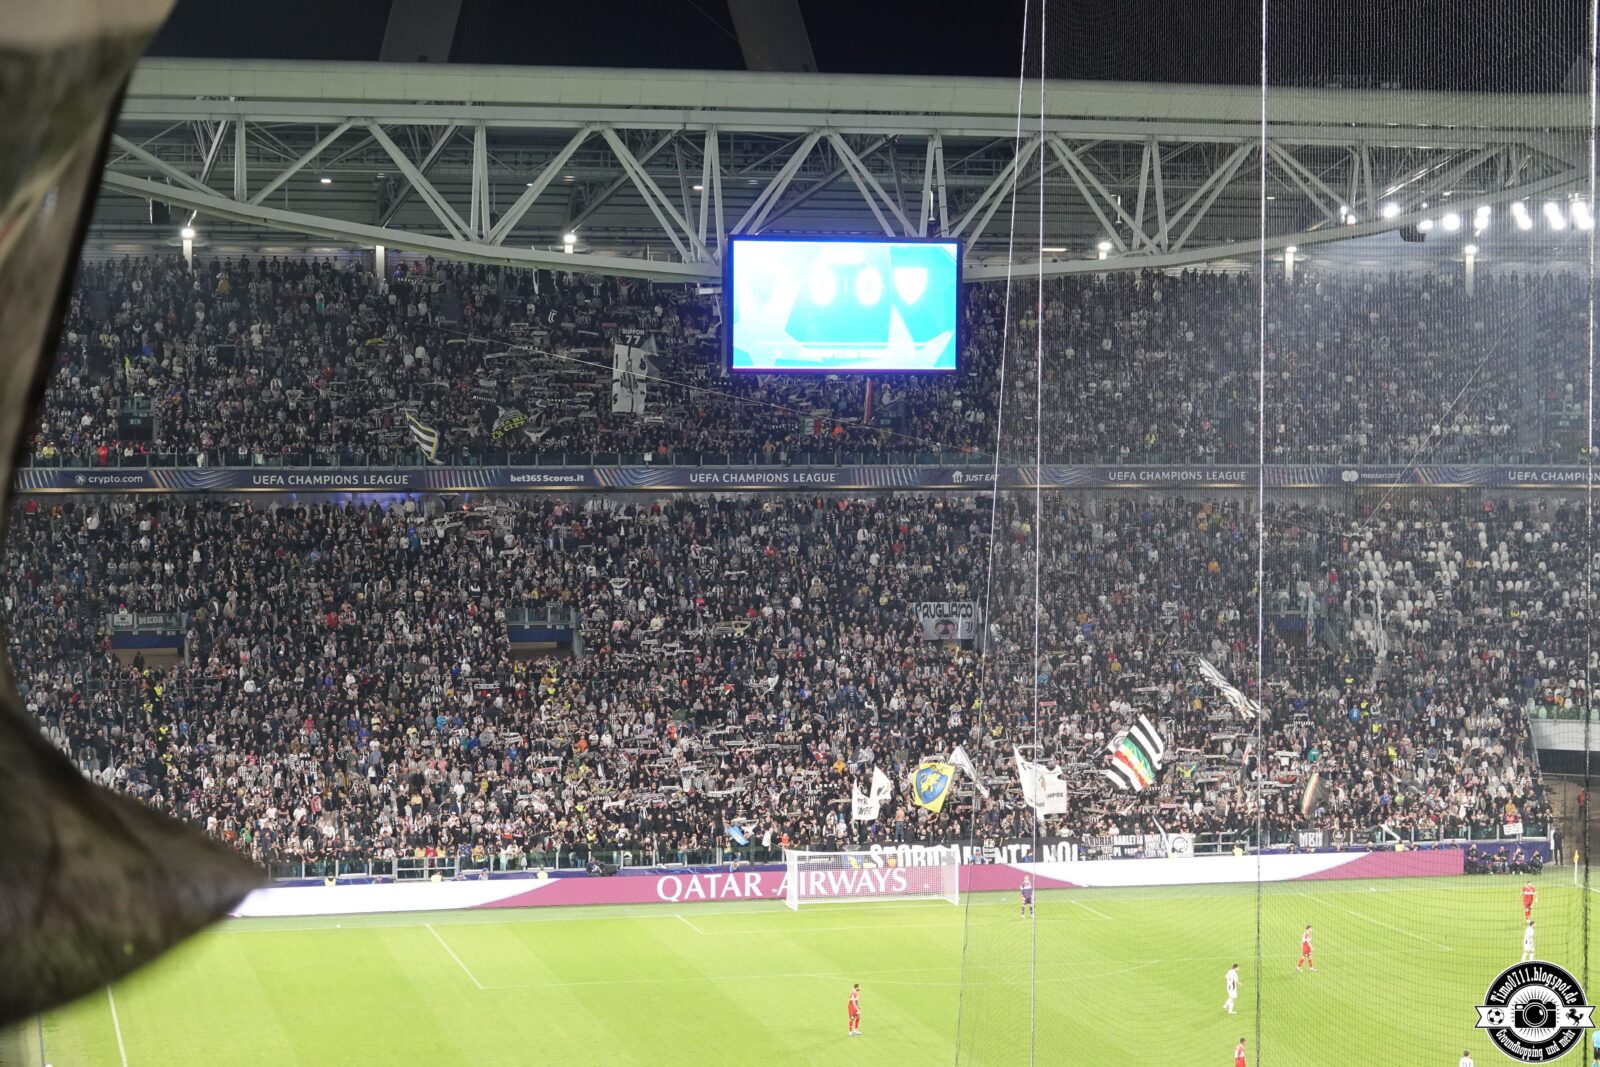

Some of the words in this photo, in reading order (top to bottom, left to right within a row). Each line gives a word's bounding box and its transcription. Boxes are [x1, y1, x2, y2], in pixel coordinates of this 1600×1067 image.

[625, 335, 641, 345] 77
[88, 475, 143, 484] crypto.com
[252, 475, 285, 485] UEFA
[287, 475, 359, 485] CHAMPIONS
[363, 475, 409, 485] LEAGUE
[689, 473, 720, 483] UEFA
[722, 473, 789, 483] CHAMPIONS
[793, 473, 836, 483] LEAGUE
[964, 474, 984, 482] JUST
[1108, 471, 1137, 481] UEFA
[1139, 471, 1202, 481] CHAMPIONS
[1206, 471, 1247, 481] LEAGUE
[1508, 471, 1538, 481] UEFA
[656, 872, 763, 902] QATAR
[776, 867, 907, 897] AIRWAYS
